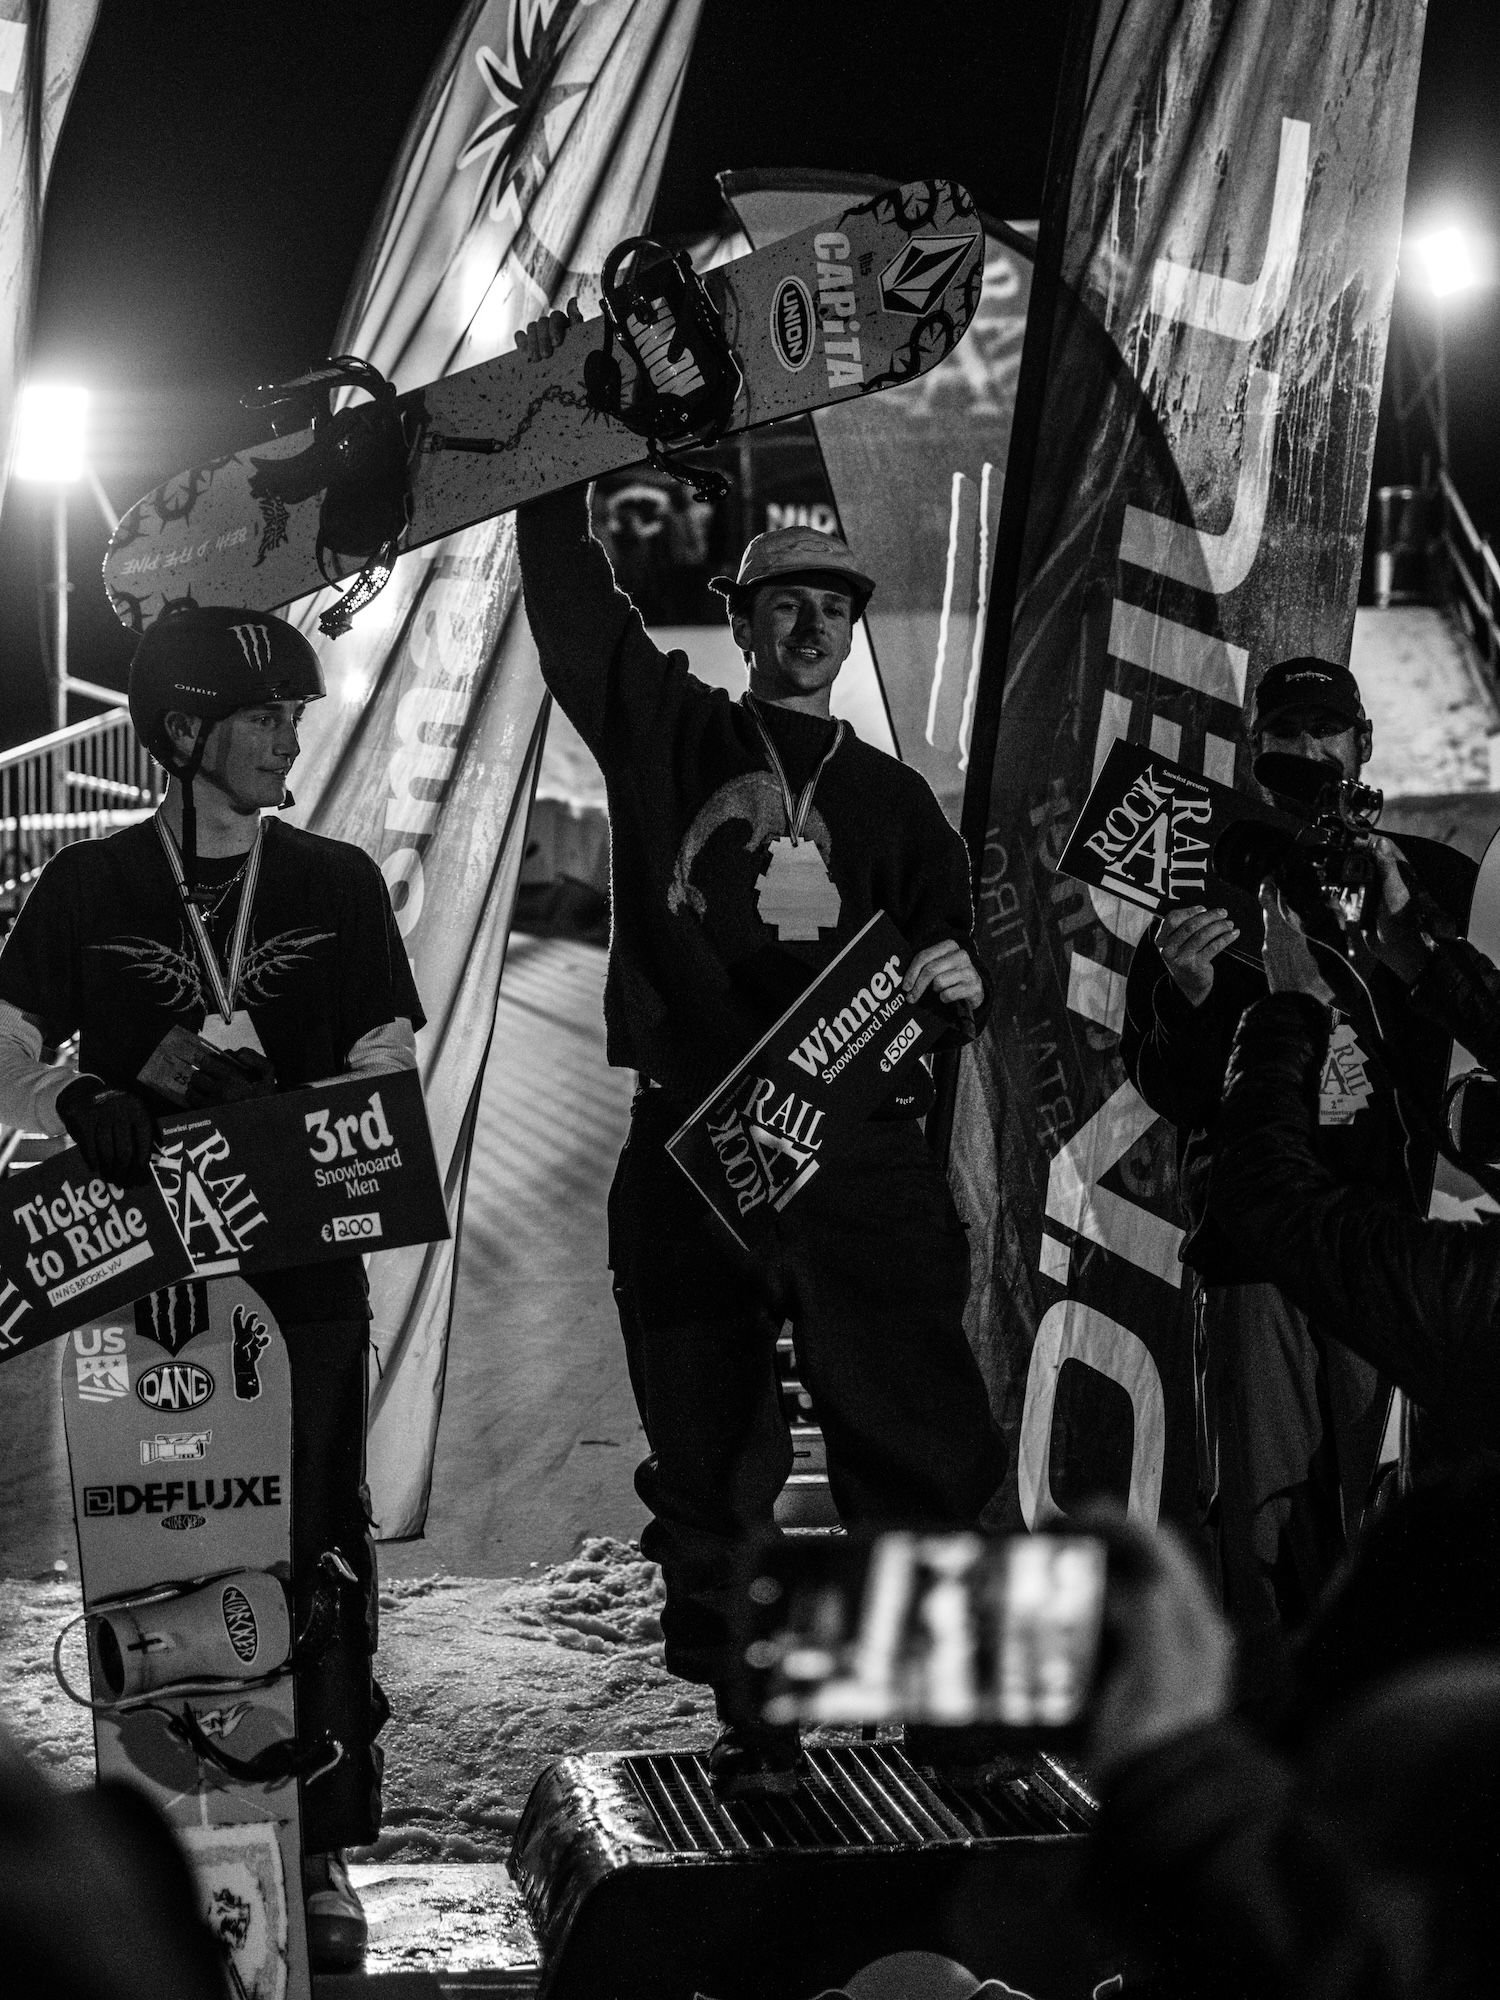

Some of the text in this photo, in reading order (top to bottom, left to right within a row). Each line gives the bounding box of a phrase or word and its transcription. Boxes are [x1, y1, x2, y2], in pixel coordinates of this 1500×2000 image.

[782, 289, 803, 358] UNION
[174, 683, 218, 697] OAKLEY
[1185, 776, 1210, 792] presents
[1083, 764, 1213, 900] ROCK A RAIL
[788, 955, 903, 1077] Winner
[821, 993, 906, 1085] Snowboard Men
[887, 1025, 915, 1060] 500
[1320, 1043, 1367, 1096] RAIL A
[305, 1091, 395, 1164] 3rd
[742, 1076, 826, 1151] RAIL
[186, 1128, 269, 1252] RAIL
[314, 1148, 403, 1188] Snowboard
[345, 1178, 380, 1199] Men
[706, 1108, 767, 1218] ROCK
[749, 1124, 813, 1203] A
[26, 1203, 148, 1287] to Ride
[183, 1170, 239, 1259] A
[337, 1217, 374, 1238] 200
[73, 1327, 126, 1356] US
[142, 1366, 208, 1409] DANG
[116, 1475, 282, 1516] DEFLUXE
